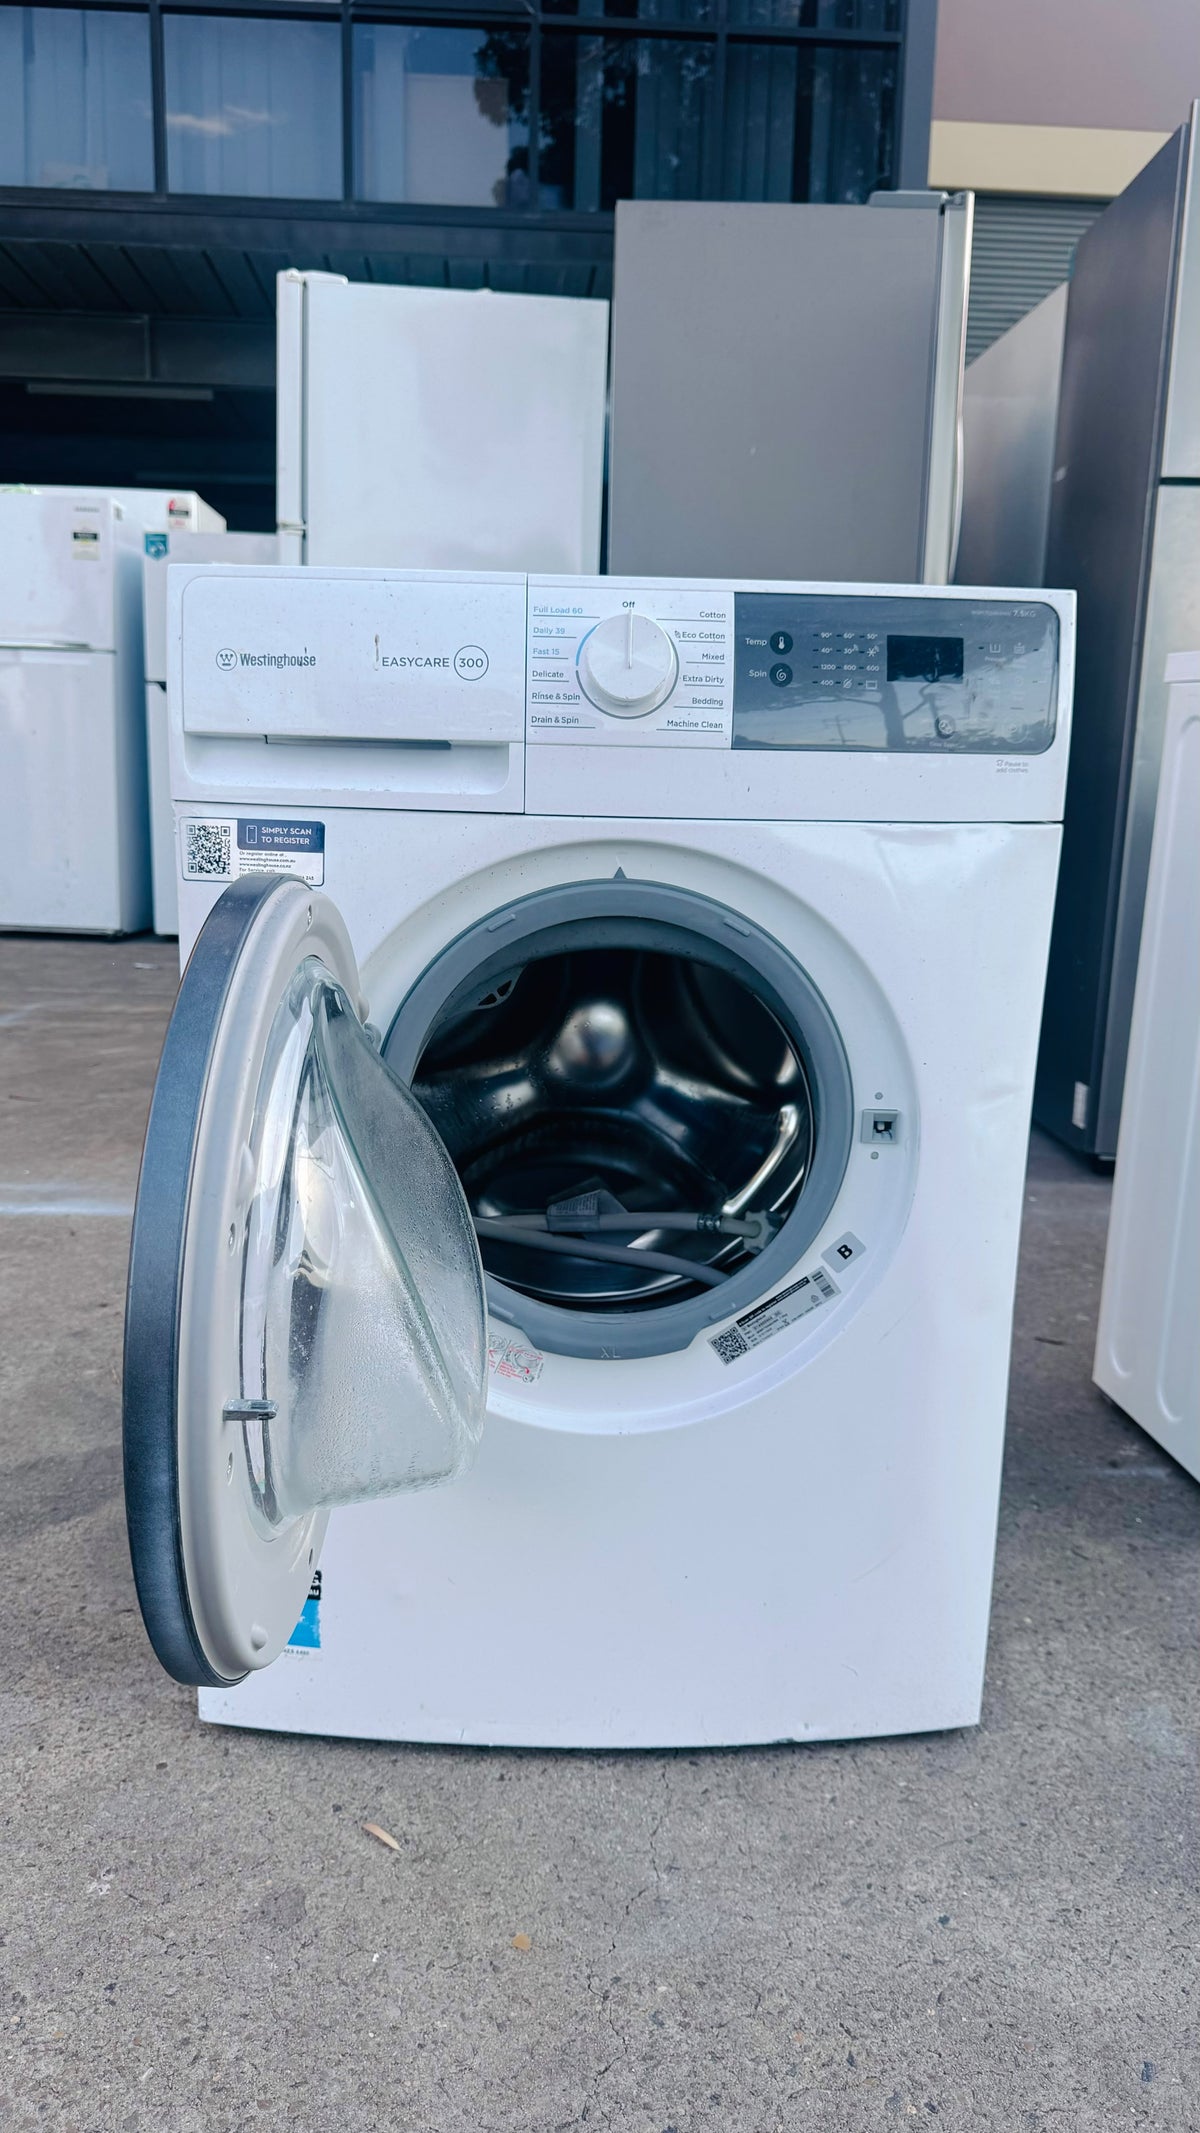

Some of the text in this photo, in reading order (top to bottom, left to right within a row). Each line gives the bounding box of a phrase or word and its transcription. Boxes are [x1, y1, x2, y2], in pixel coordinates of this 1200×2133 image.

[699, 611, 726, 619] Cotton
[533, 627, 553, 635] Daily
[682, 631, 726, 640] Eco Cotton
[745, 637, 767, 646] Temp
[239, 653, 316, 669] Westinghouse
[701, 653, 725, 661] Mixed
[382, 656, 484, 668] EASYCARE 300
[532, 670, 564, 678] Delicate
[749, 669, 767, 678] Spin
[705, 676, 724, 684] Dirty
[532, 692, 554, 700] Rinse
[562, 693, 580, 701] Spin
[692, 698, 724, 706] Bedding
[667, 720, 699, 728] Machine
[274, 837, 310, 845] REGISTER
[837, 1244, 853, 1260] B
[600, 1345, 621, 1358] XL
